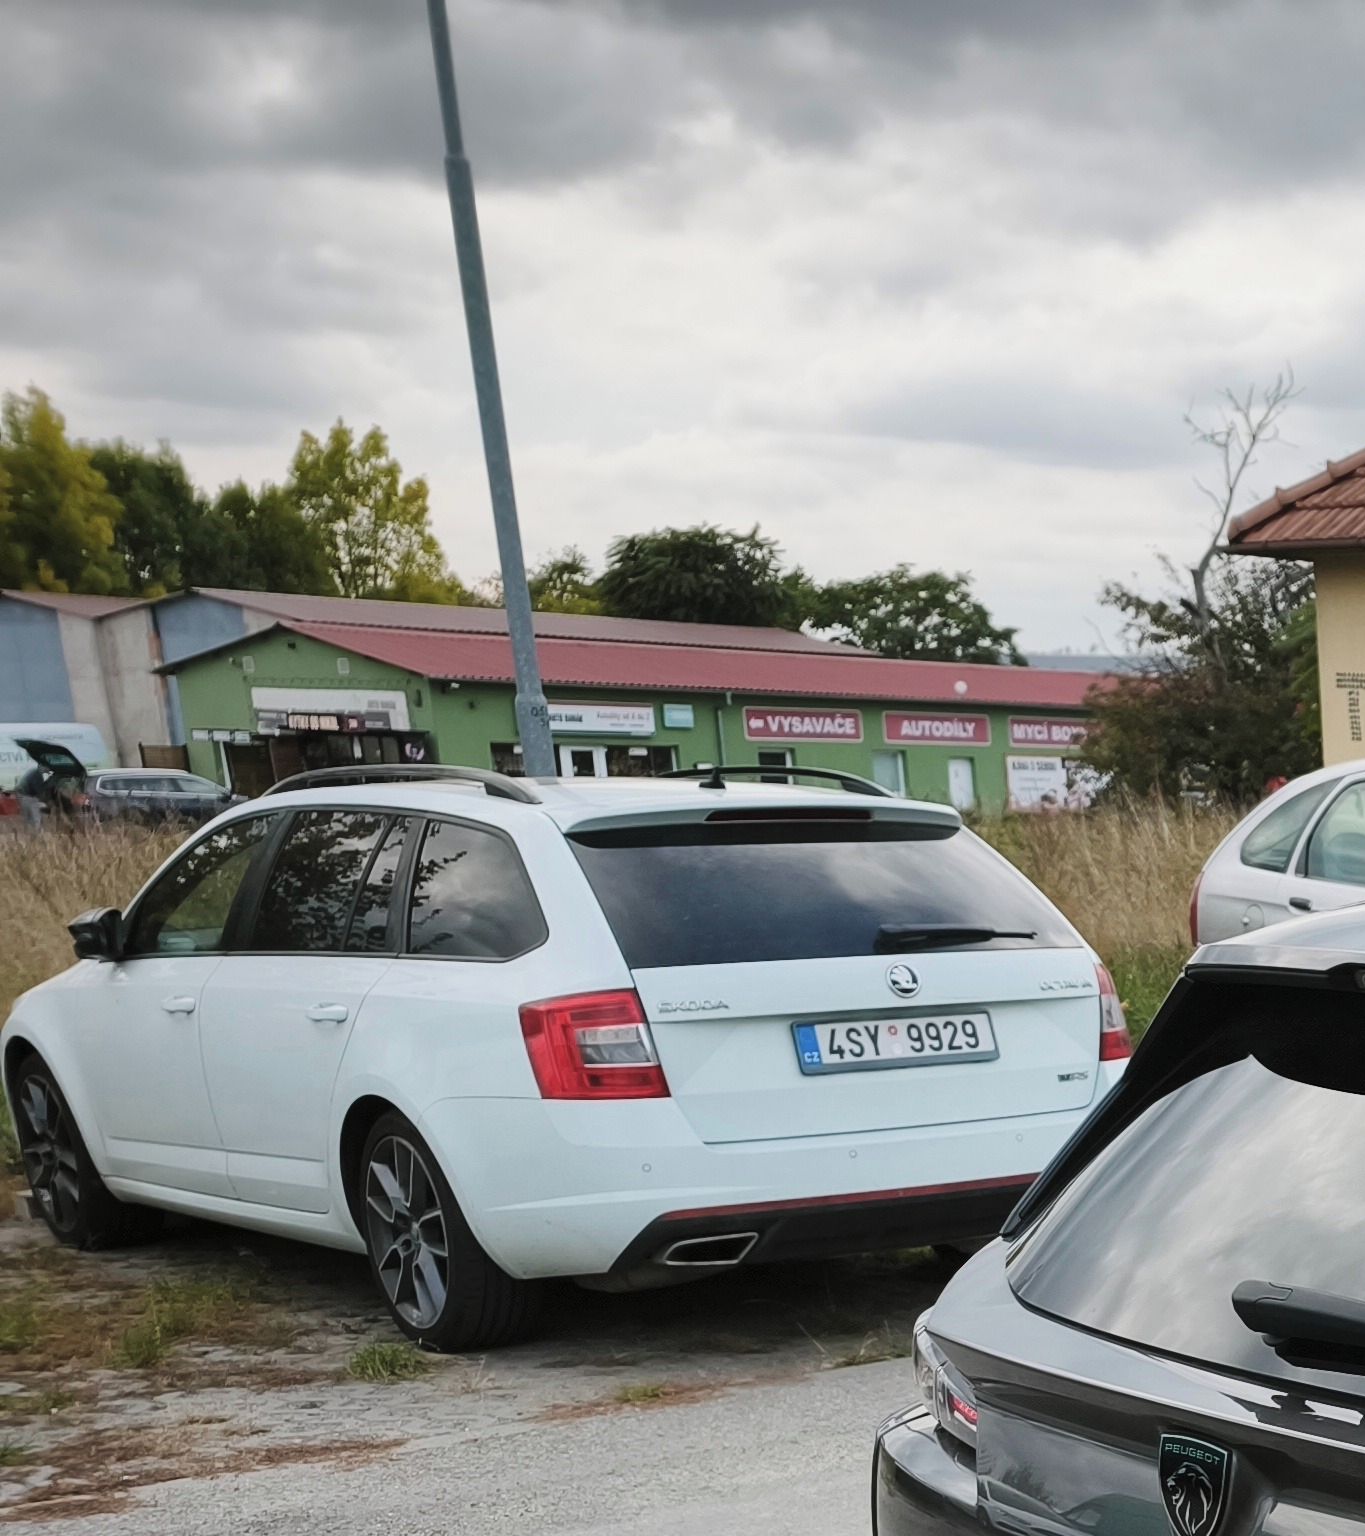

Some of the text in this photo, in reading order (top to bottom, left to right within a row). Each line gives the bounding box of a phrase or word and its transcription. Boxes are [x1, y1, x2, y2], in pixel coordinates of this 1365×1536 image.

[766, 714, 856, 735] VYSAVAČE
[901, 718, 976, 738] AUTODÍLY
[1013, 721, 1048, 740] MYCÍ
[804, 1020, 980, 1063] CZ 4SY 9929
[1165, 1443, 1220, 1464] PEUGEOT
